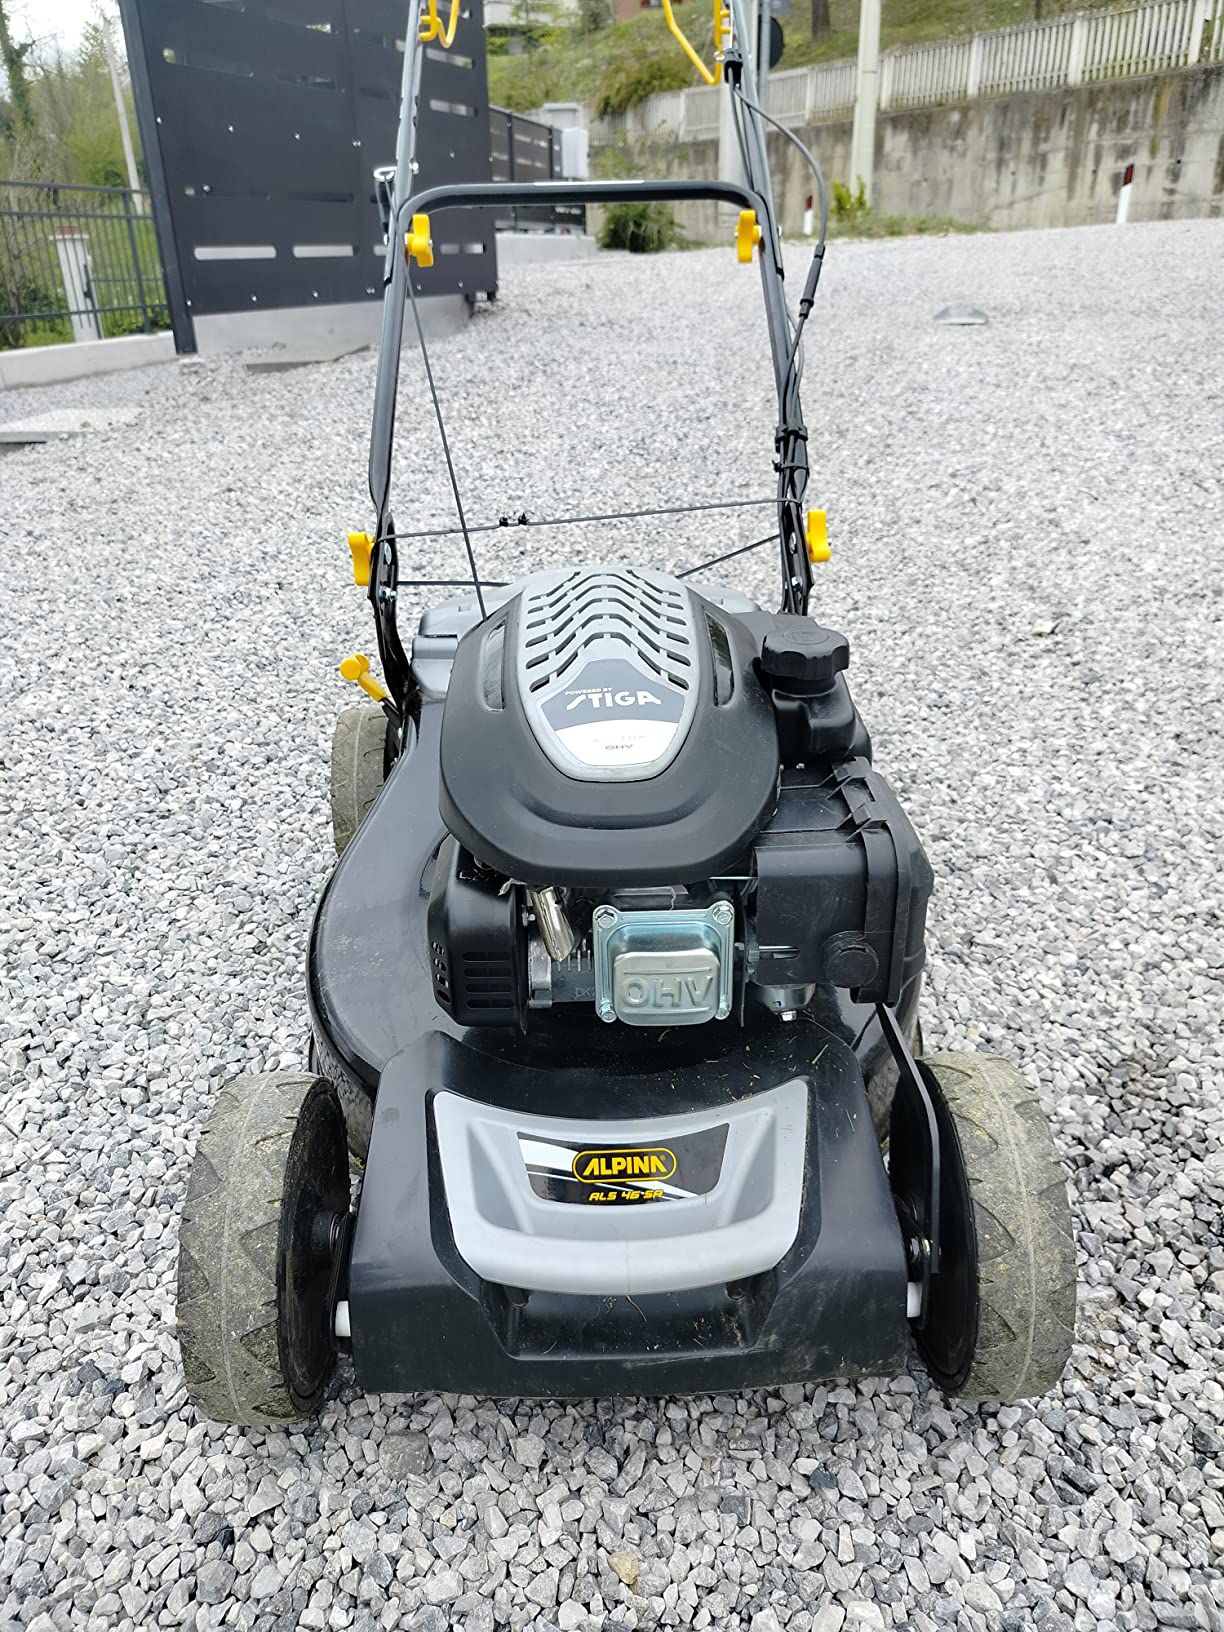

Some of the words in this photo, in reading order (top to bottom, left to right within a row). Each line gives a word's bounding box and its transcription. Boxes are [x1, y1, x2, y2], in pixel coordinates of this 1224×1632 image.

[566, 690, 662, 711] STIGA
[621, 975, 713, 1007] OHV
[583, 1155, 667, 1176] ALPINA
[589, 1191, 617, 1201] ALS
[621, 1189, 641, 1201] 46
[645, 1189, 663, 1199] SA
